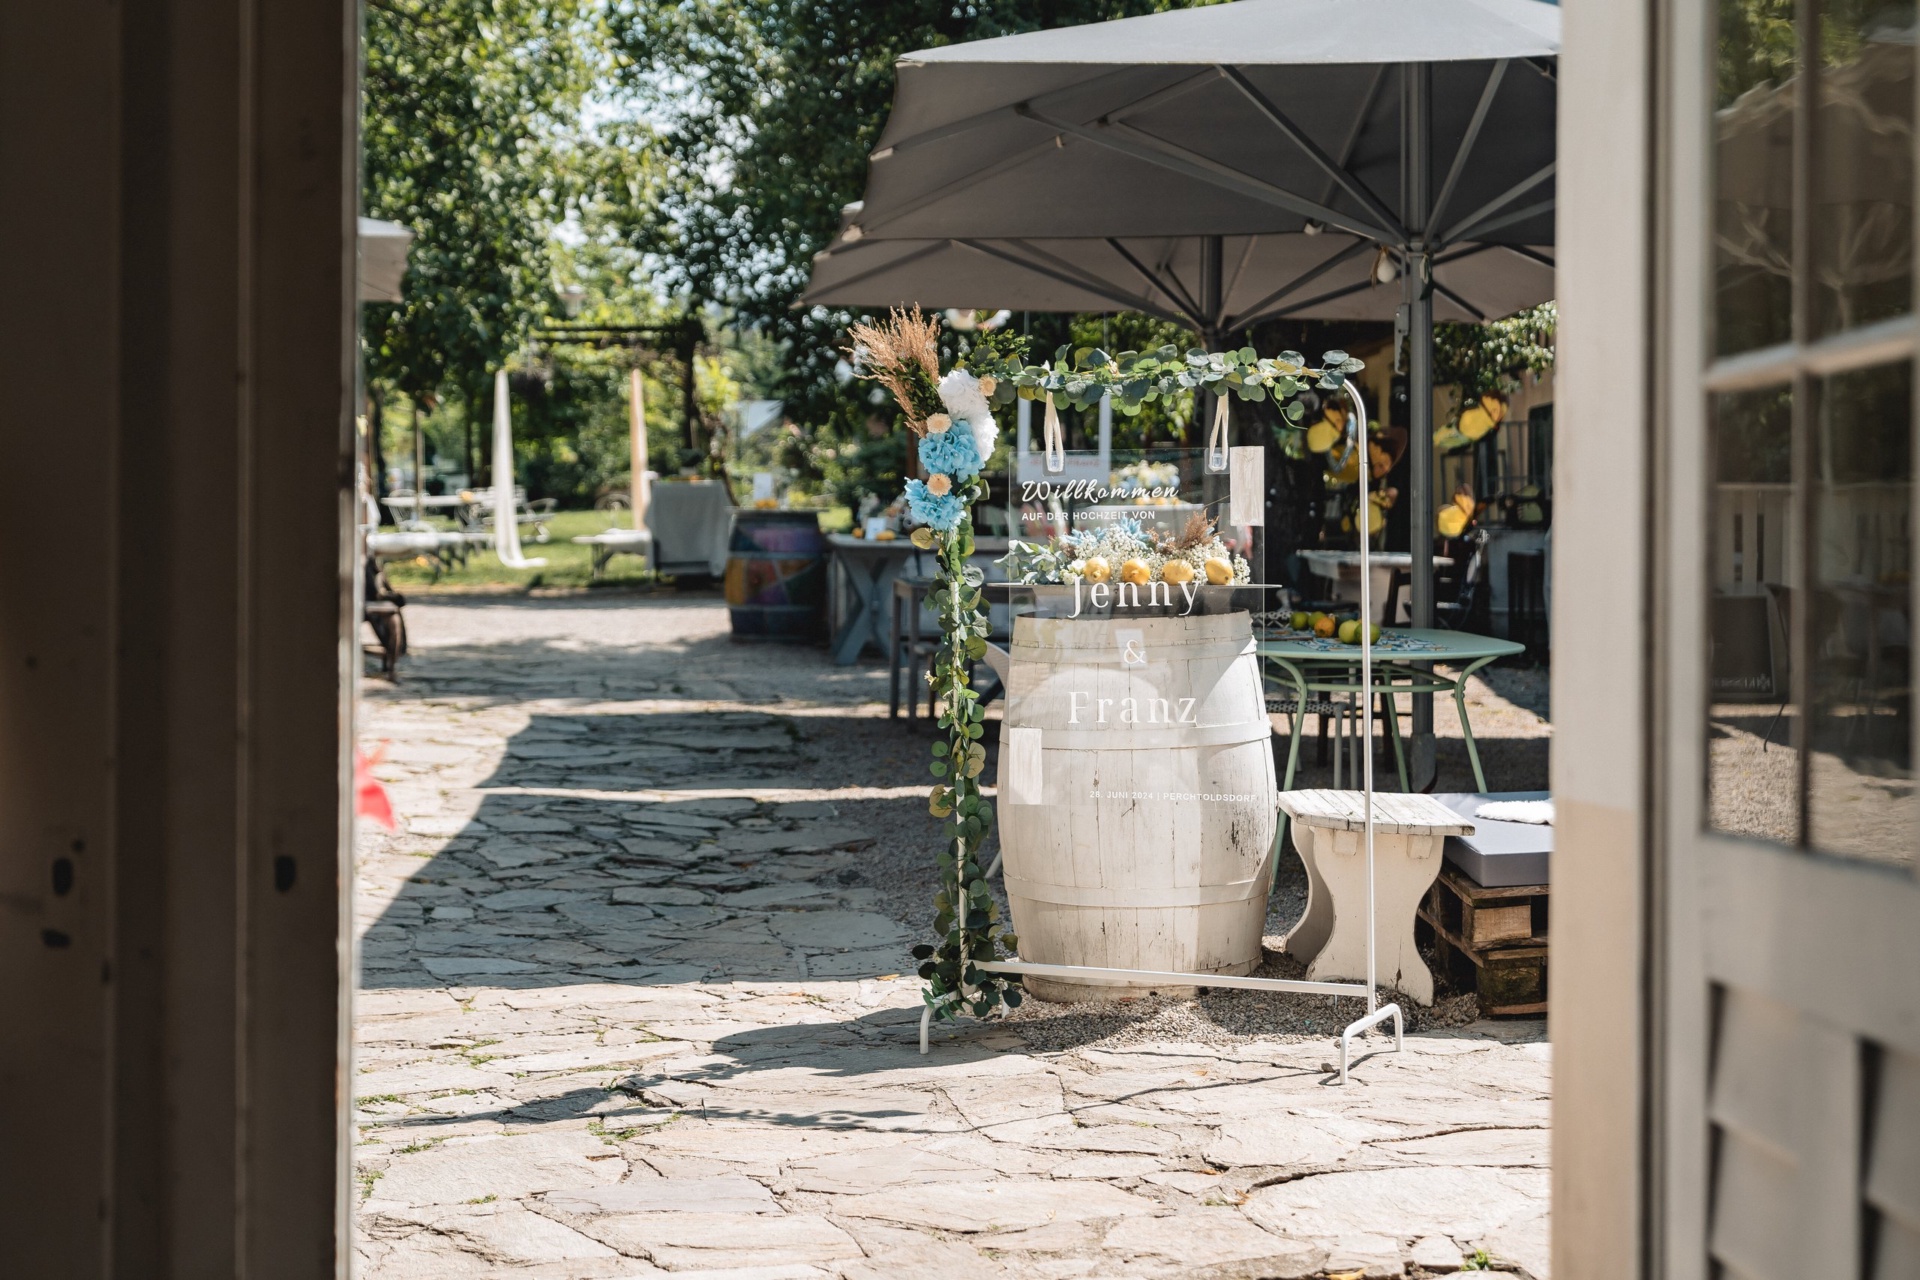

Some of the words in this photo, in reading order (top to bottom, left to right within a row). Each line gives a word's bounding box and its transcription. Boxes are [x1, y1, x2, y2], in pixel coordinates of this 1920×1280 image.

[1021, 479, 1179, 503] Willkommen
[1021, 512, 1041, 521] AUF
[1046, 512, 1069, 521] DER
[1073, 511, 1128, 520] HOCHZEIT
[1132, 510, 1155, 520] VON
[1067, 576, 1200, 618] Jenny
[1123, 640, 1145, 664] &
[1067, 691, 1197, 724] Franz
[1106, 791, 1128, 799] JUNI
[1163, 792, 1256, 802] PERCHTOLDSDORF
